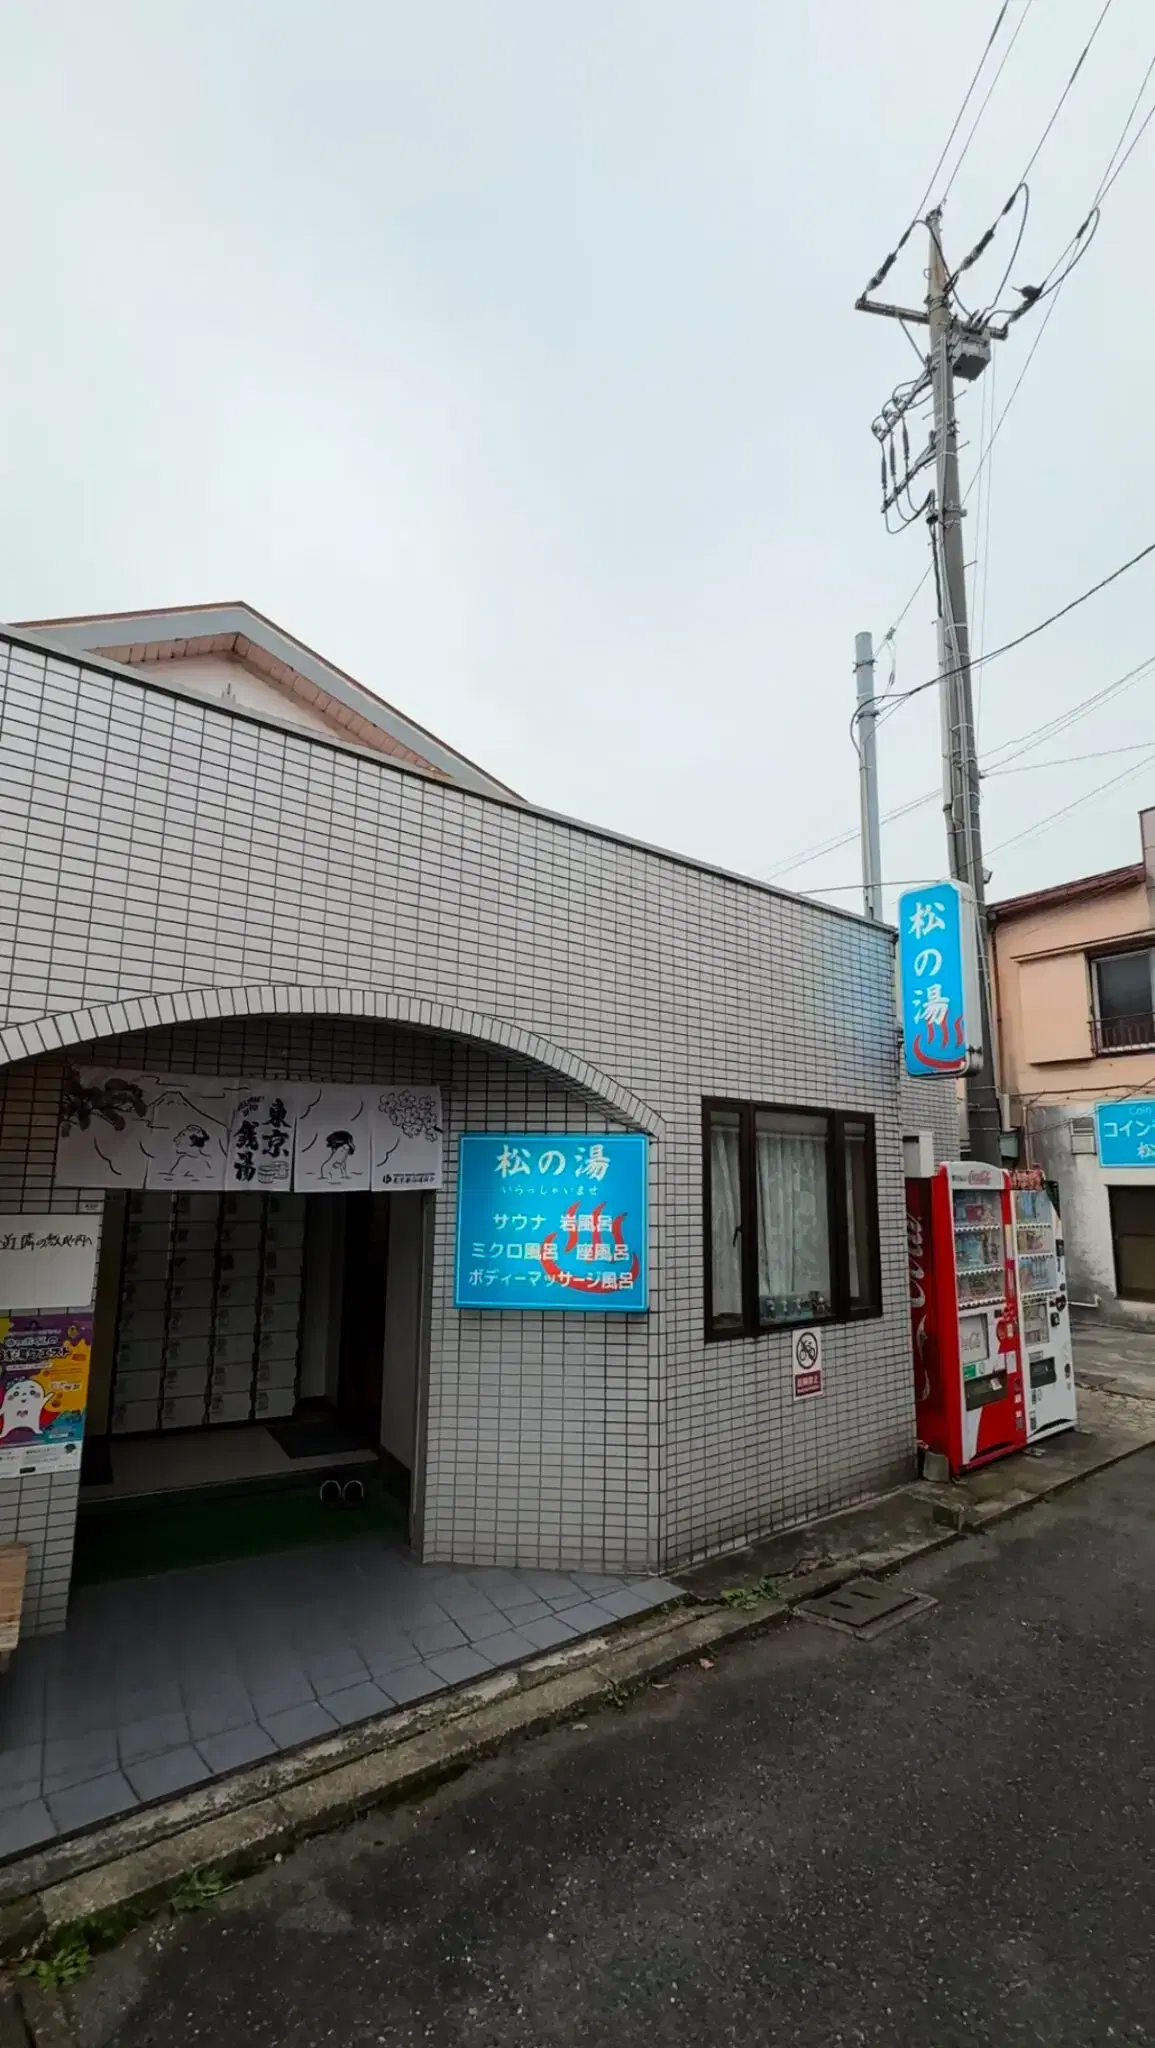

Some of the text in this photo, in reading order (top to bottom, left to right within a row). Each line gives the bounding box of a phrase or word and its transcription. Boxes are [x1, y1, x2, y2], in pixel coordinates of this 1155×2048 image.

[908, 902, 950, 1026] 松の湯
[262, 1098, 291, 1158] 東京
[234, 1120, 259, 1182] 銭湯
[494, 1144, 611, 1181] 松の湯
[501, 1185, 599, 1196] いらっしゃいませ
[493, 1213, 613, 1232] サウナ 岩風呂
[471, 1242, 630, 1262] ミクロ風呂 座風呂
[468, 1268, 634, 1290] ボディーマッサージ風呂
